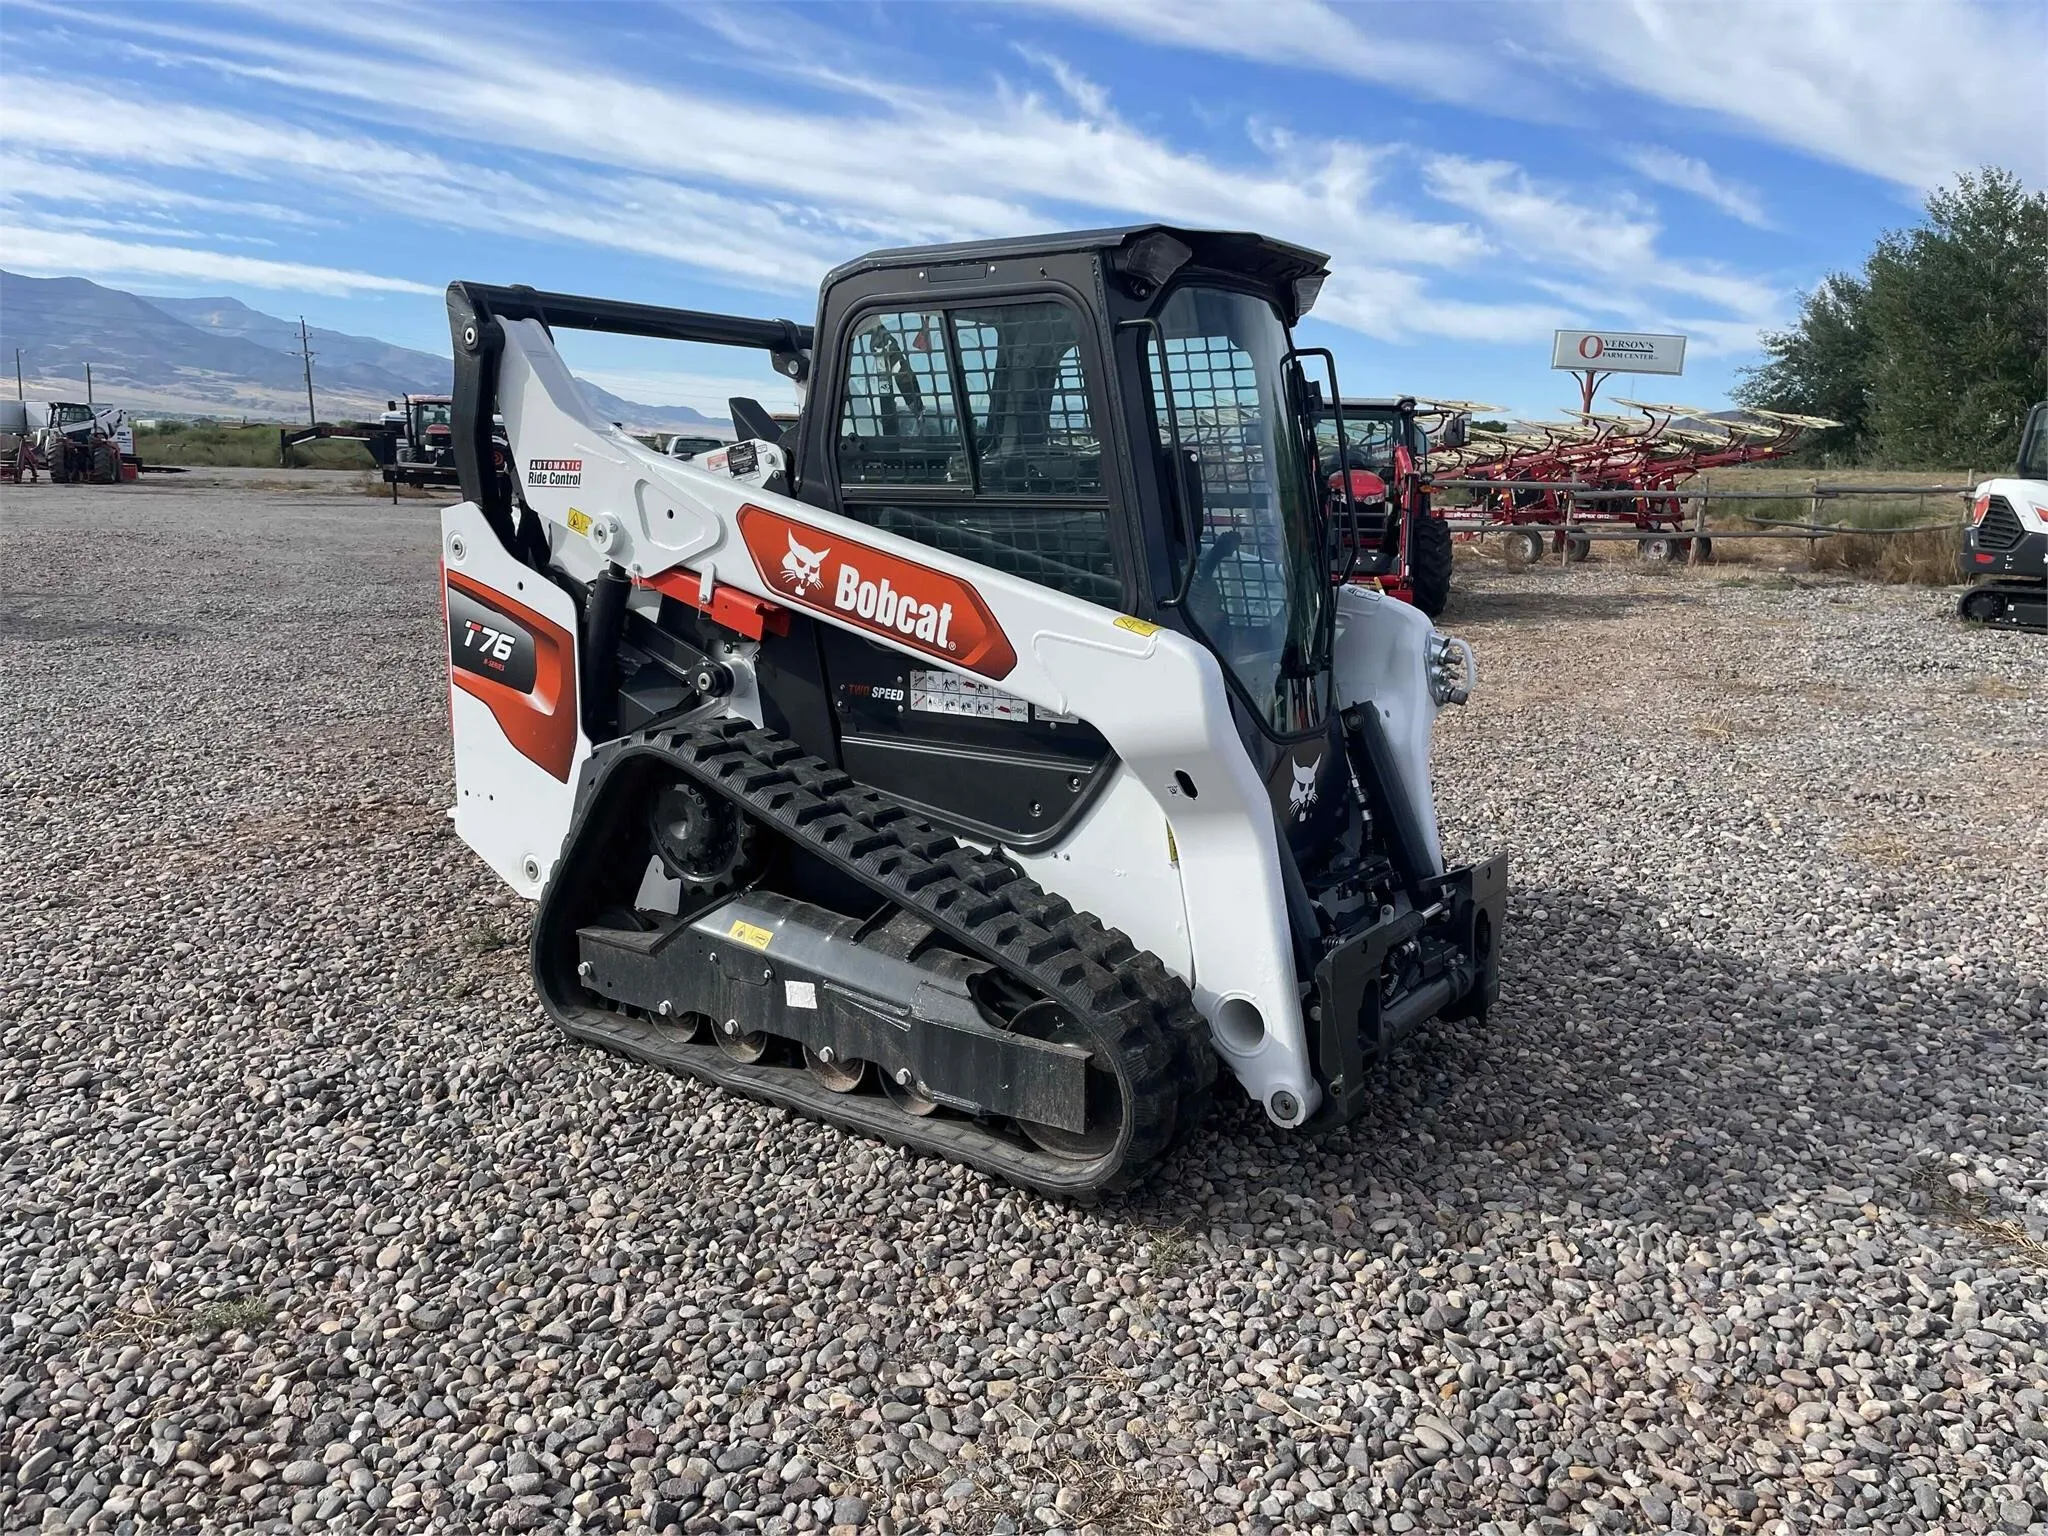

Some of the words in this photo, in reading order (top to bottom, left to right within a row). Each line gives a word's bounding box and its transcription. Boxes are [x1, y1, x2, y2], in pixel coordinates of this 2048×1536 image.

[1579, 335, 1654, 359] OVERSON'S
[1602, 351, 1623, 359] FARM
[531, 460, 581, 470] AUTOMATIC
[528, 472, 547, 484] Ride
[550, 472, 581, 485] Control
[835, 563, 952, 649] Bobcat
[464, 620, 516, 661] T76
[849, 684, 870, 696] TWO
[872, 686, 904, 700] SPEED
